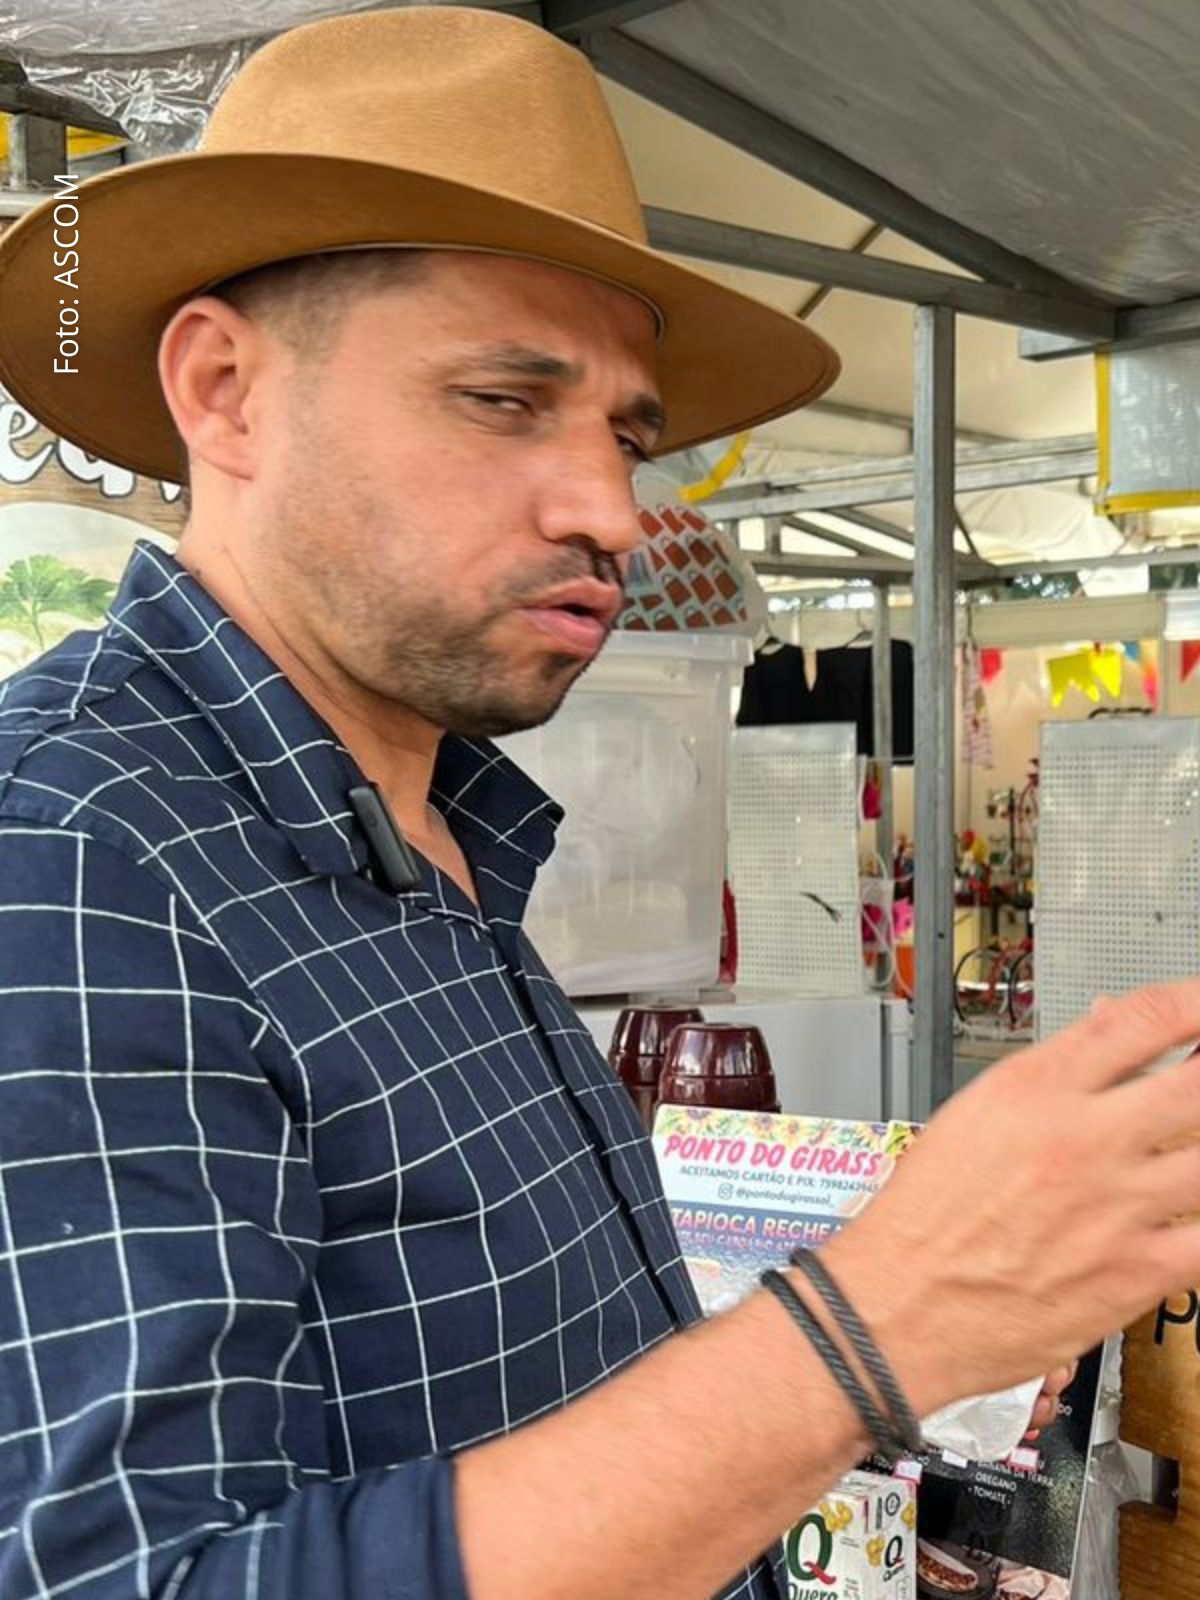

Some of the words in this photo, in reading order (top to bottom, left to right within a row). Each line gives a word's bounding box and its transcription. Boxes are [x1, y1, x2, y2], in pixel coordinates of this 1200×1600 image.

[664, 1133, 747, 1165] PONTO
[750, 1141, 785, 1167] DO
[680, 1164, 741, 1181] ACEITAMOS
[742, 1168, 784, 1186] CARTÃO
[787, 1176, 794, 1186] E
[671, 1207, 757, 1235] TAPIOCA
